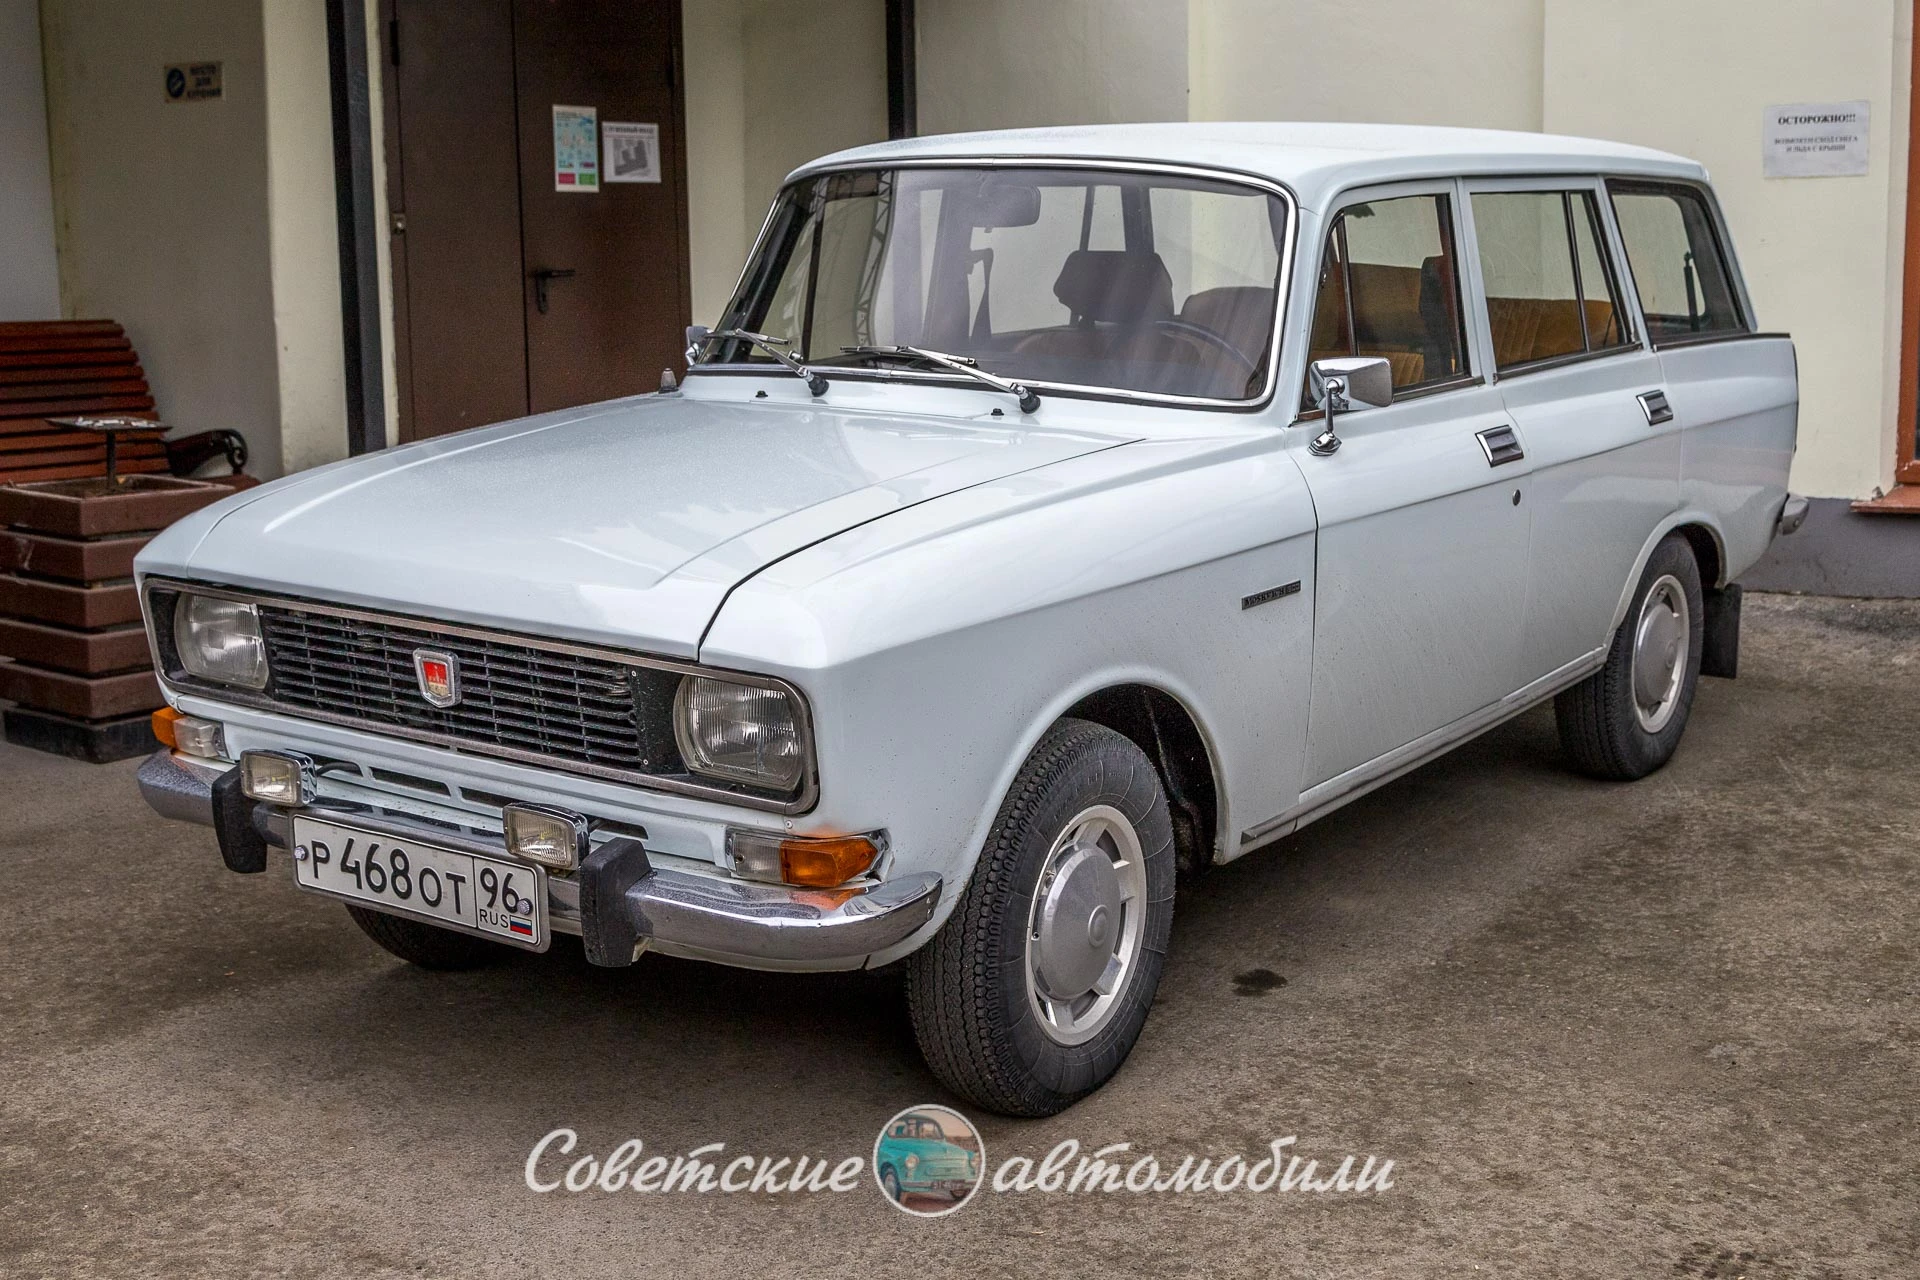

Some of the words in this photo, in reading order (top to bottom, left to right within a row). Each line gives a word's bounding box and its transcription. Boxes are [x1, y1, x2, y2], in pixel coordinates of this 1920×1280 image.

[1778, 114, 1856, 125] ОСТОРОЖНО!!!
[479, 867, 520, 913] 96
[479, 908, 509, 929] RUS
